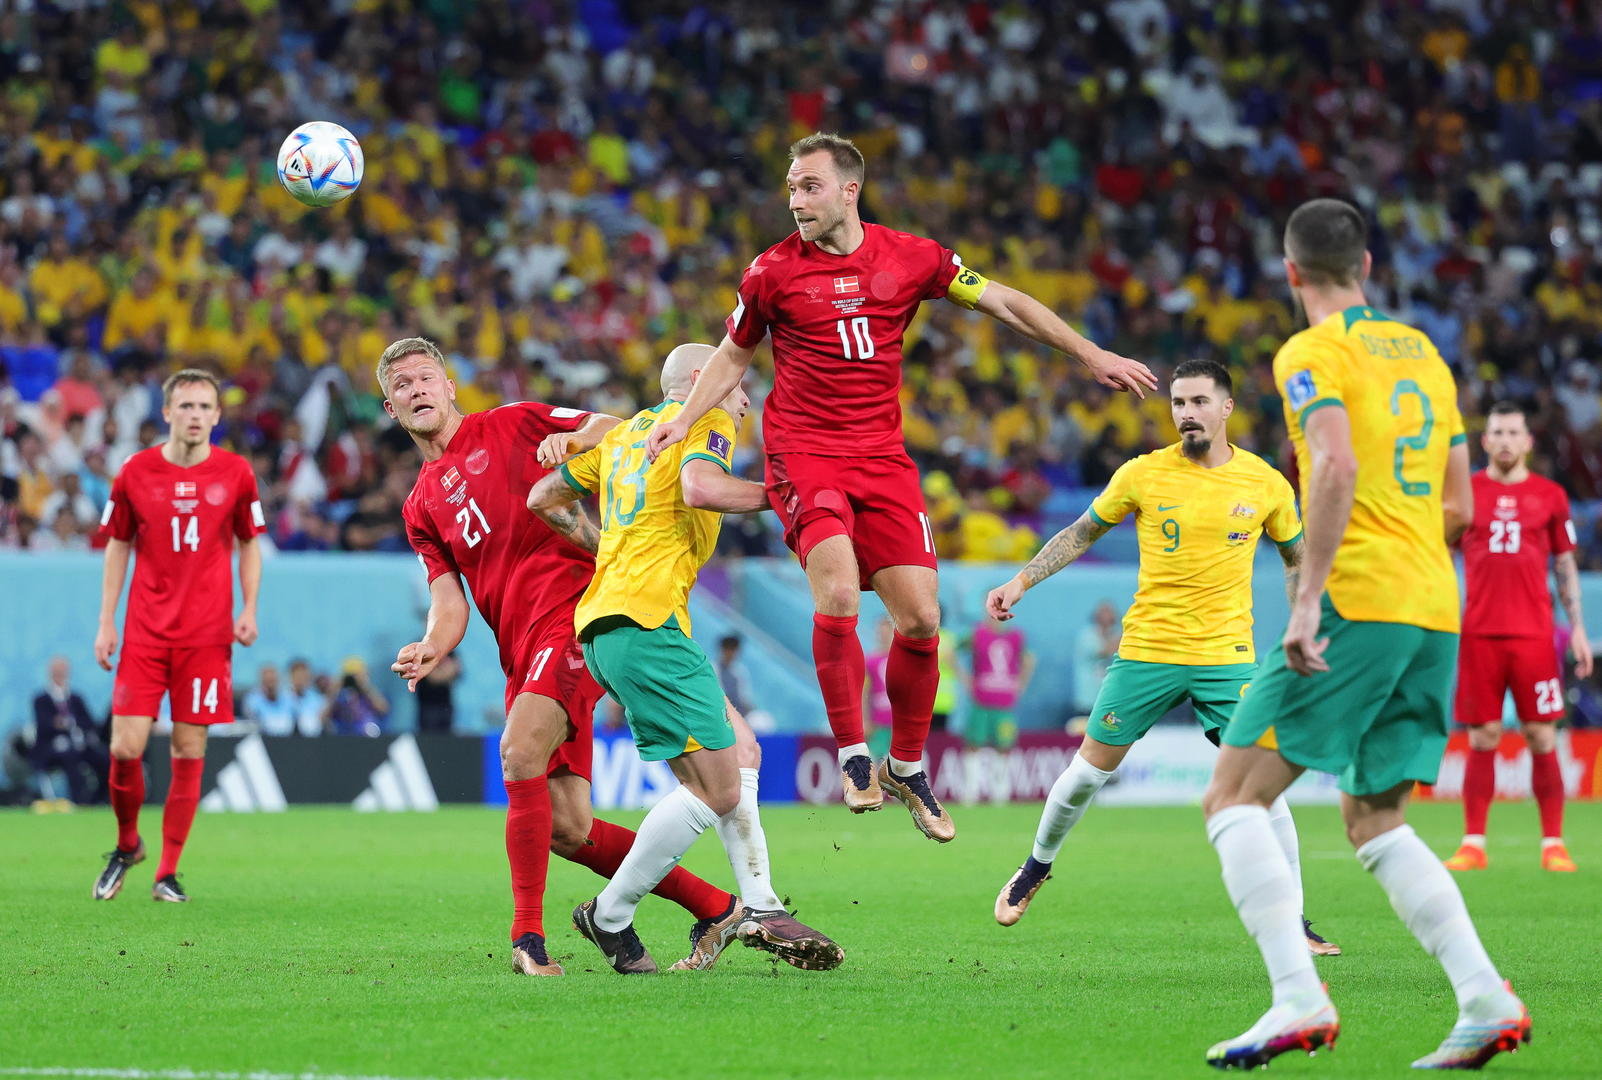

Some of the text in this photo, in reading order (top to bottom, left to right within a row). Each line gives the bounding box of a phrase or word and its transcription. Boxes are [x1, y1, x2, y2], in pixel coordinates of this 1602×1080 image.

[837, 316, 874, 360] 10
[1390, 379, 1434, 496] 2
[603, 440, 651, 532] 13
[171, 515, 200, 552] 14
[456, 497, 491, 549] 21
[1161, 518, 1180, 553] 9
[1488, 520, 1521, 553] 23
[192, 677, 218, 714] 14
[1534, 677, 1564, 715] 23
